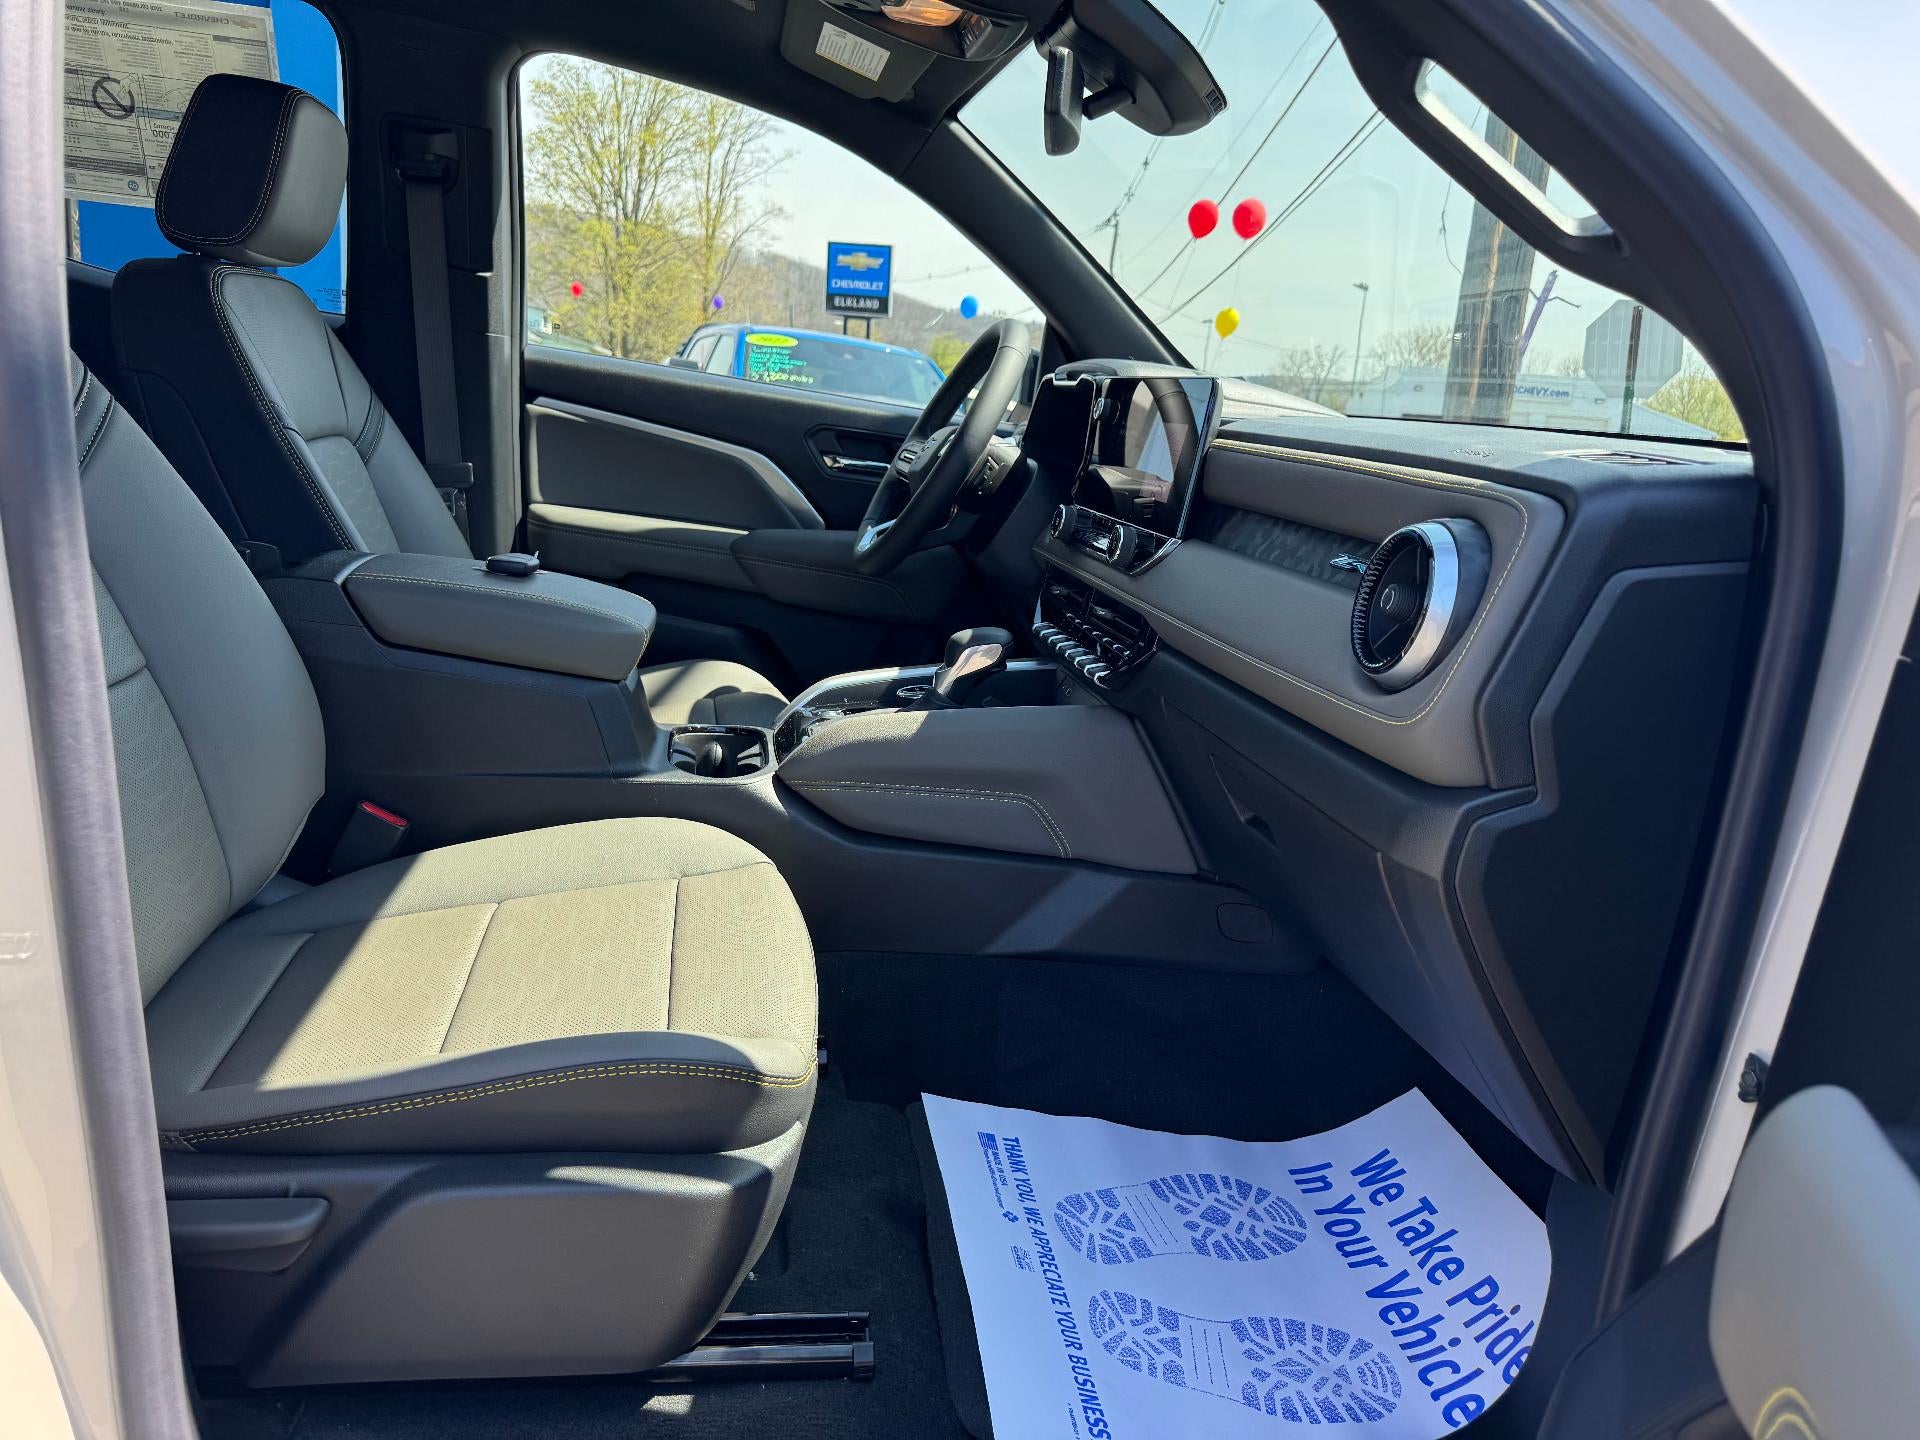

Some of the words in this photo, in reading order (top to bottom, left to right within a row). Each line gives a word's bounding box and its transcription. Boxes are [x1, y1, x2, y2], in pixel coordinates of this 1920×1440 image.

[831, 278, 884, 291] CHEVROLET
[833, 295, 880, 310] ELKLAND
[1514, 384, 1570, 398] CHEVY.com
[1002, 1136, 1029, 1176] THANK
[1013, 1177, 1037, 1203] YOU,
[1022, 1206, 1045, 1227] WE
[1029, 1226, 1071, 1309] APPRECIATE
[1350, 1148, 1407, 1207] We
[1387, 1196, 1466, 1286] Take
[1446, 1274, 1535, 1385] Pride
[1288, 1162, 1333, 1194] In
[1313, 1193, 1389, 1269] Your
[1365, 1269, 1486, 1429] Vehicle
[1054, 1309, 1084, 1351] YOUR
